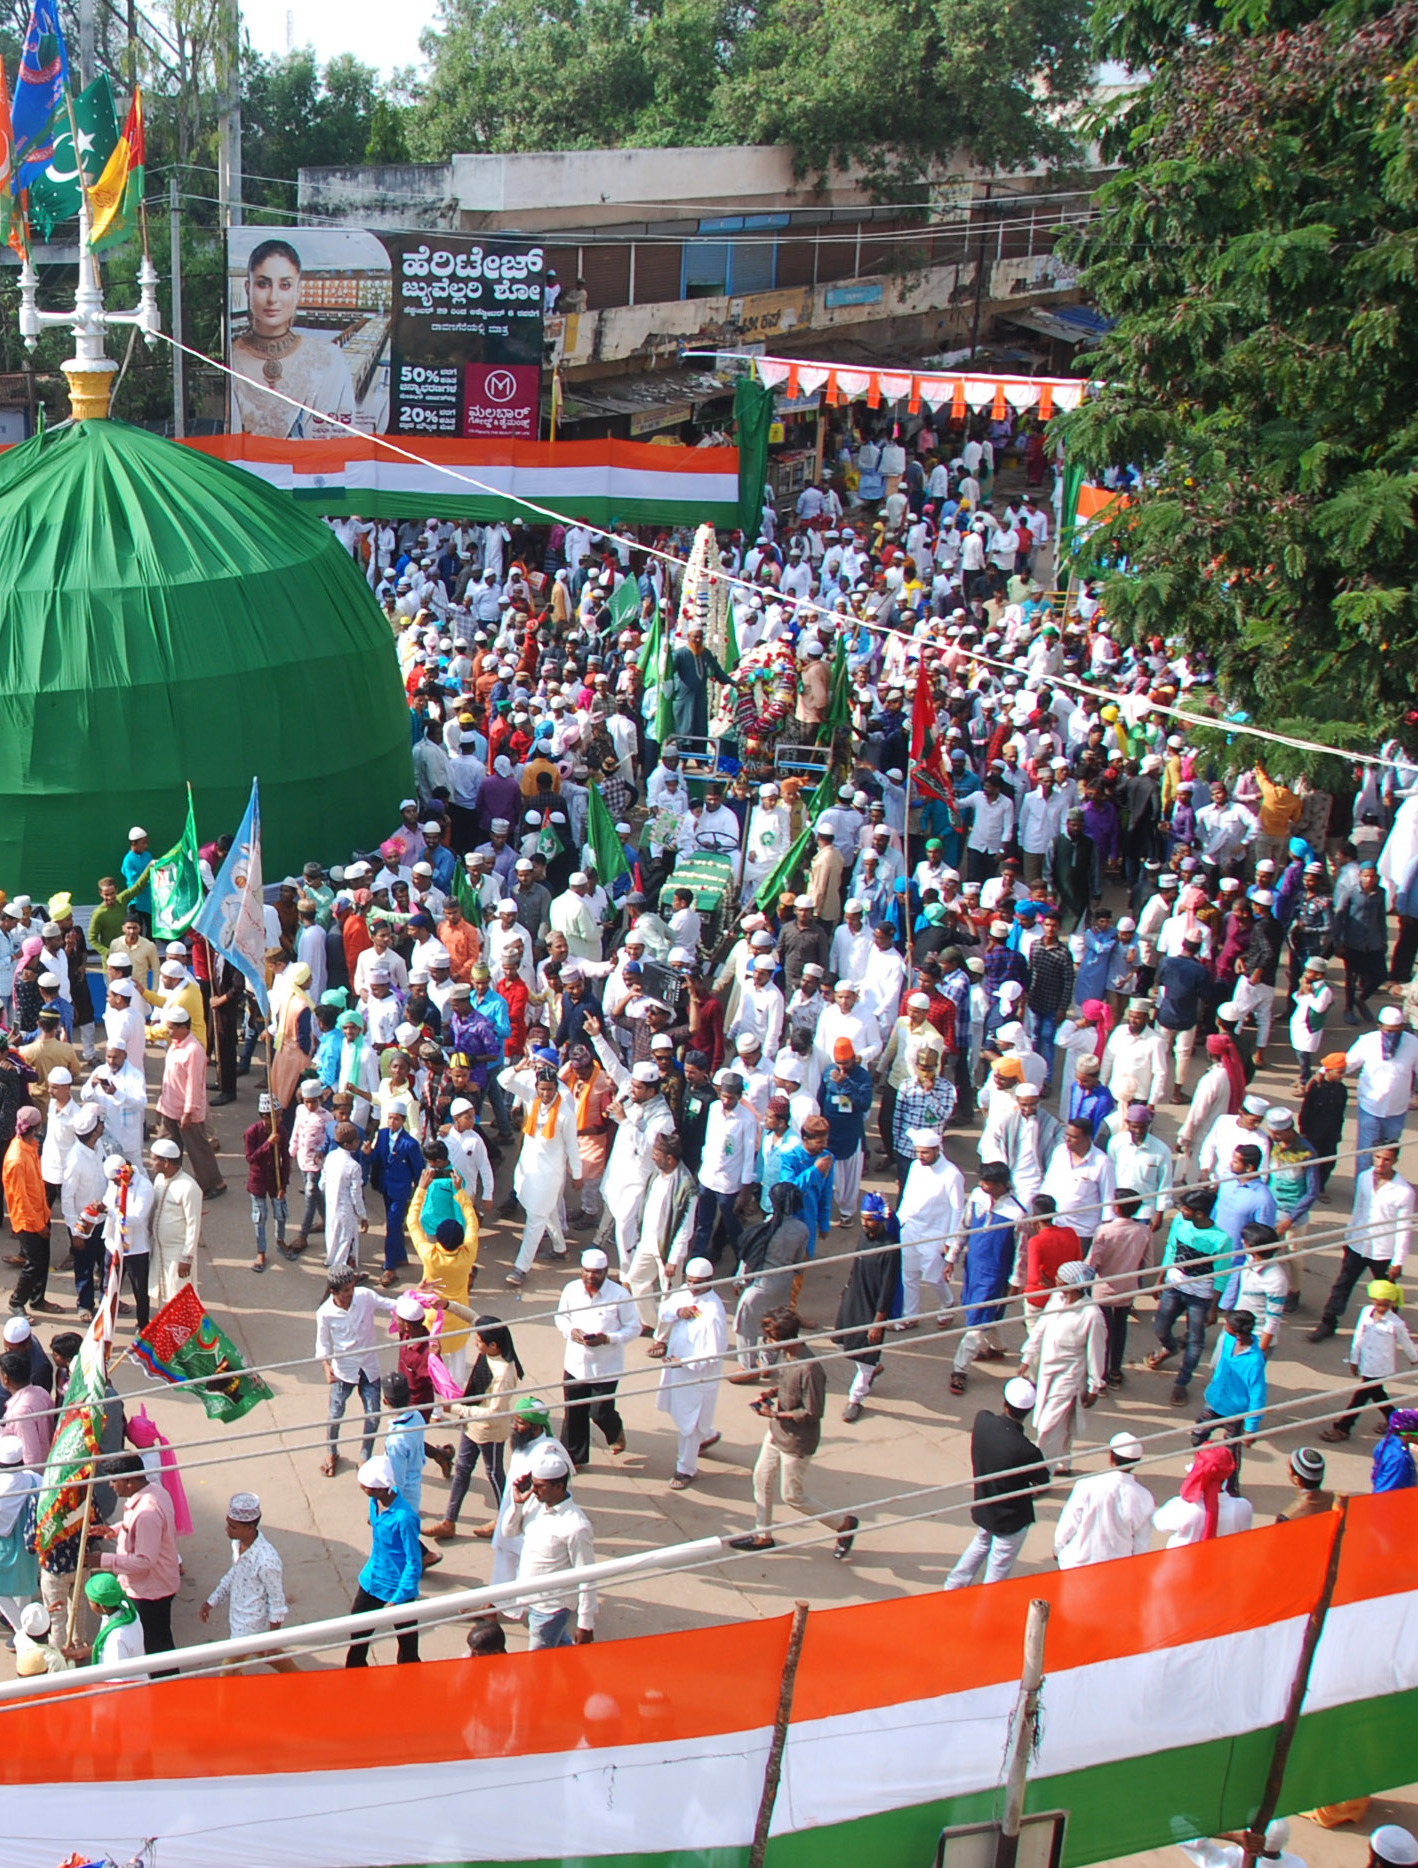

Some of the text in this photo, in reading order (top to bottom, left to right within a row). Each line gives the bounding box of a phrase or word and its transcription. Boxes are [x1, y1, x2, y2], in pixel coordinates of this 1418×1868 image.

[402, 245, 544, 279] ಹೆರಿಟೇಜ್
[401, 278, 541, 307] ಜ್ಯುವೆಲ್ಲರಿ ಶೋ
[400, 366, 440, 384] 50%
[399, 406, 439, 424] 20%
[468, 404, 531, 419] ಮಲಬಾರ್
